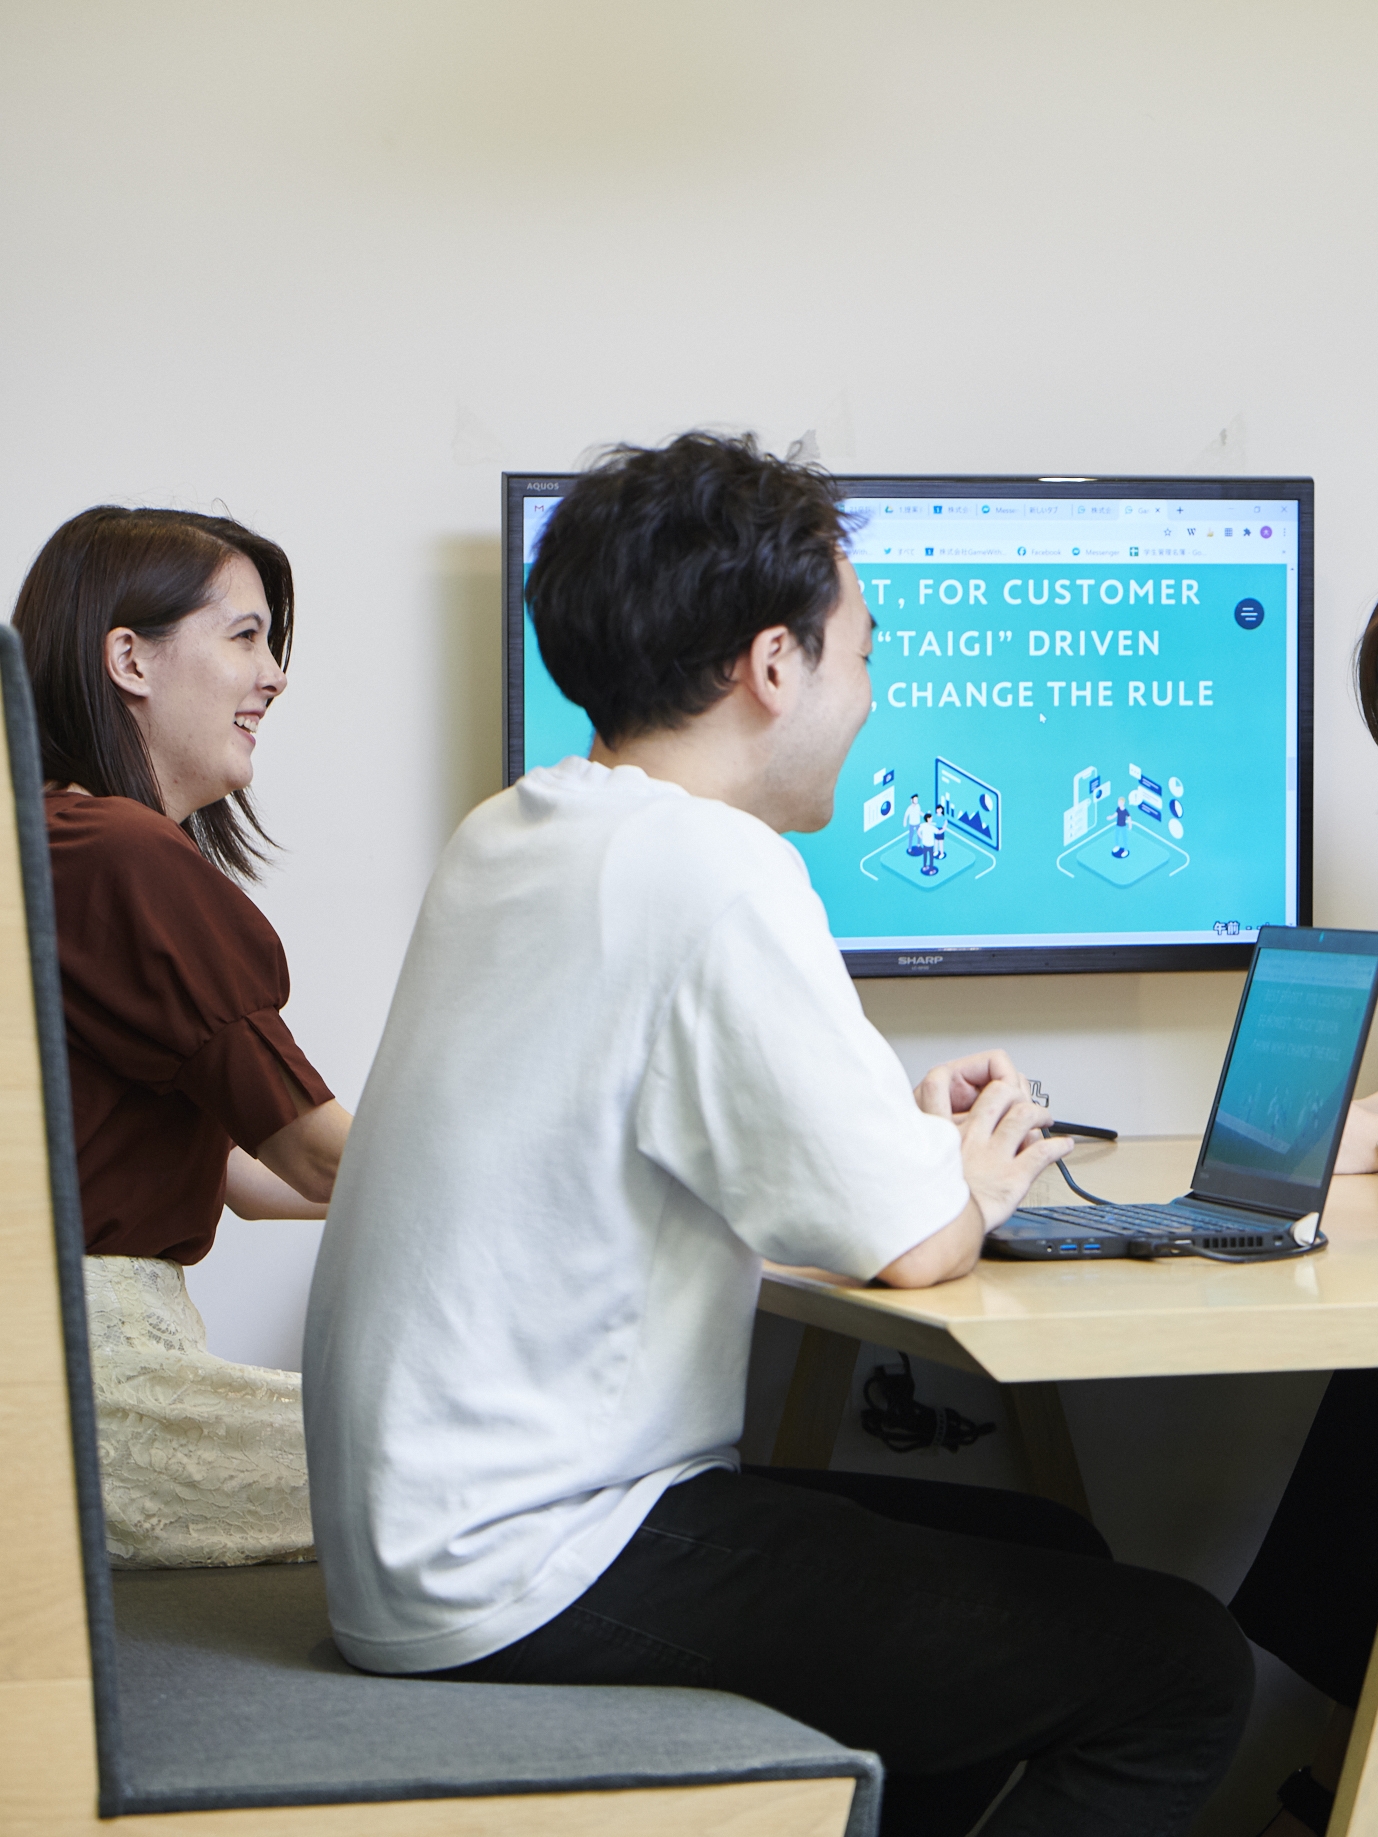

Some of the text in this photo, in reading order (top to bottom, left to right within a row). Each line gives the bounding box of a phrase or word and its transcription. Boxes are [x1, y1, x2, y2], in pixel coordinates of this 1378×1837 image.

[526, 482, 560, 492] AQUOS
[1031, 548, 1061, 556] Facebook
[1085, 549, 1120, 557] Messenger
[858, 578, 1201, 609] T, FOR CUSTOMER
[1029, 630, 1160, 656] DRIVEN
[887, 681, 1034, 708] CHANGE
[1047, 681, 1113, 706] THE
[1127, 680, 1214, 706] RULE
[1213, 920, 1240, 936] 午前
[898, 955, 944, 965] SHARP
